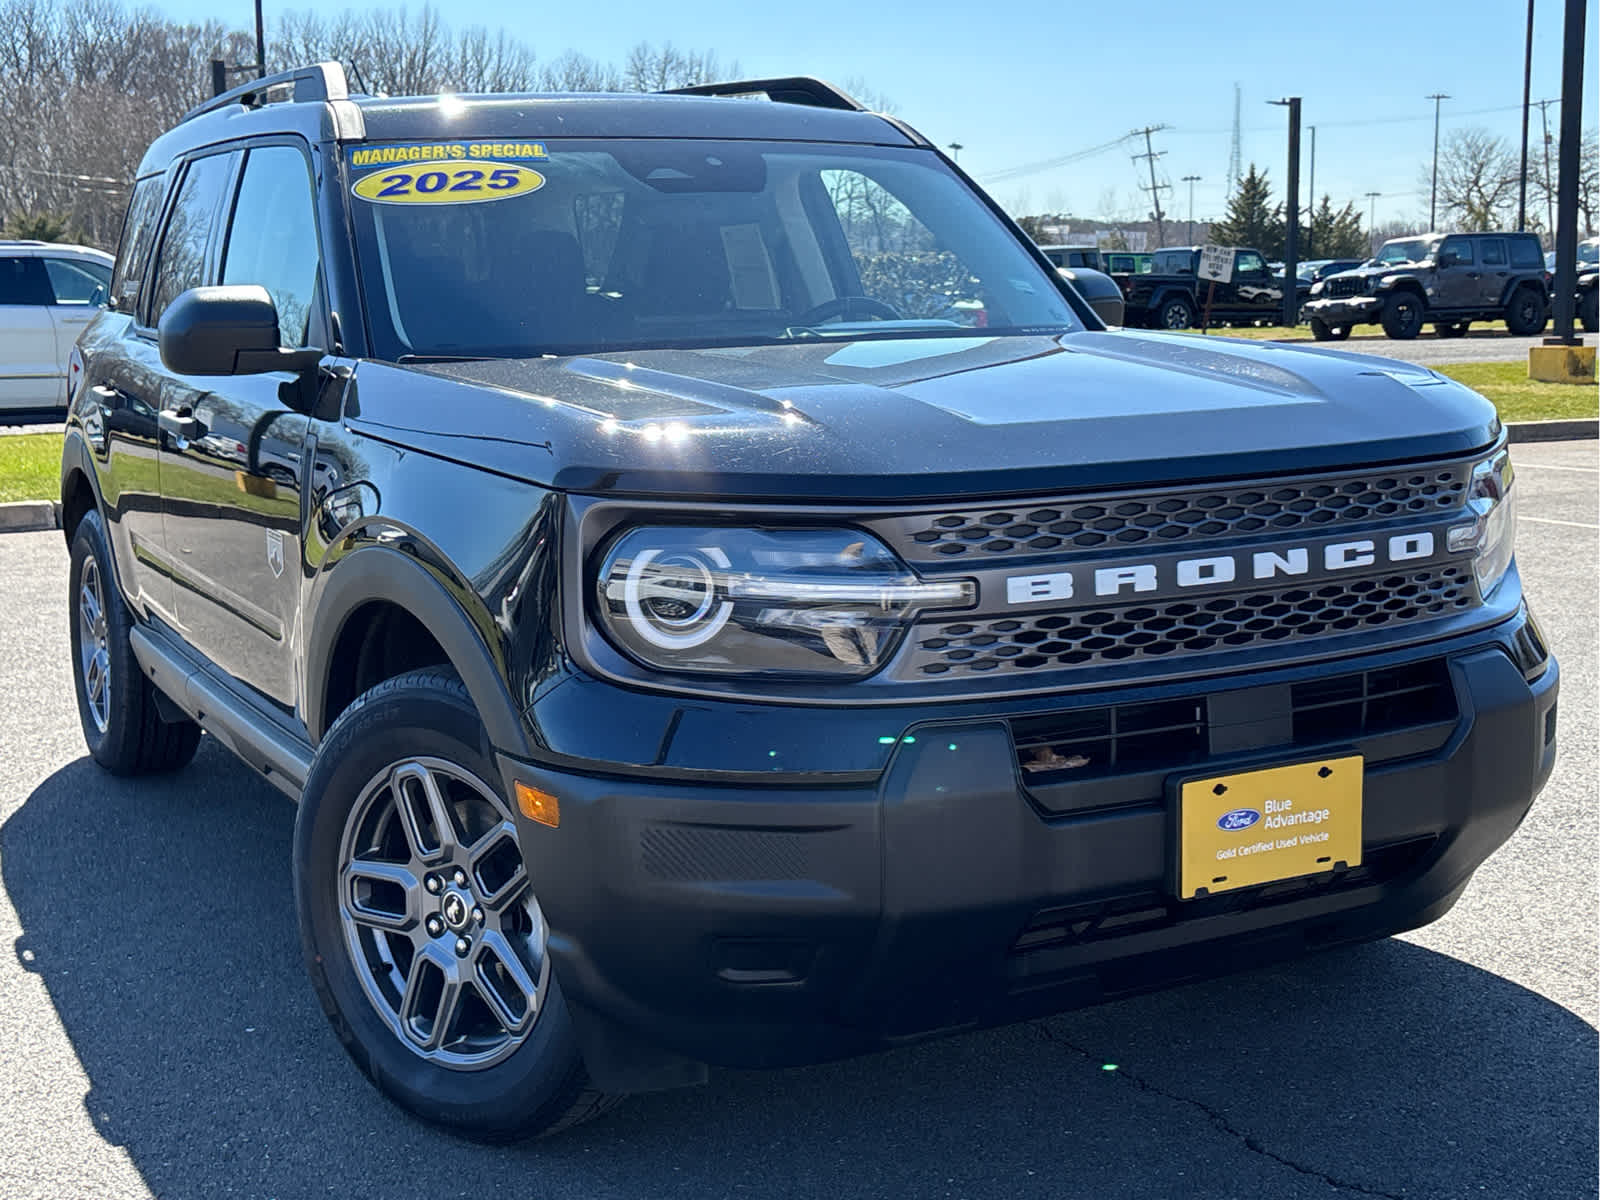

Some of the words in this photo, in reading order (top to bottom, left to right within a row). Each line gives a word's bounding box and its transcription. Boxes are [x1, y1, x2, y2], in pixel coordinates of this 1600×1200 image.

[353, 144, 464, 165] MANAGER'S
[469, 143, 548, 158] SPECIAL
[376, 169, 520, 198] 2025
[1006, 531, 1436, 605] BRONCO
[1264, 799, 1293, 814] Blue
[1264, 808, 1331, 830] Advantage
[1215, 847, 1237, 860] Gold
[1238, 841, 1273, 856] Certified
[1275, 836, 1297, 849] Used
[1299, 832, 1329, 844] Vehicle
